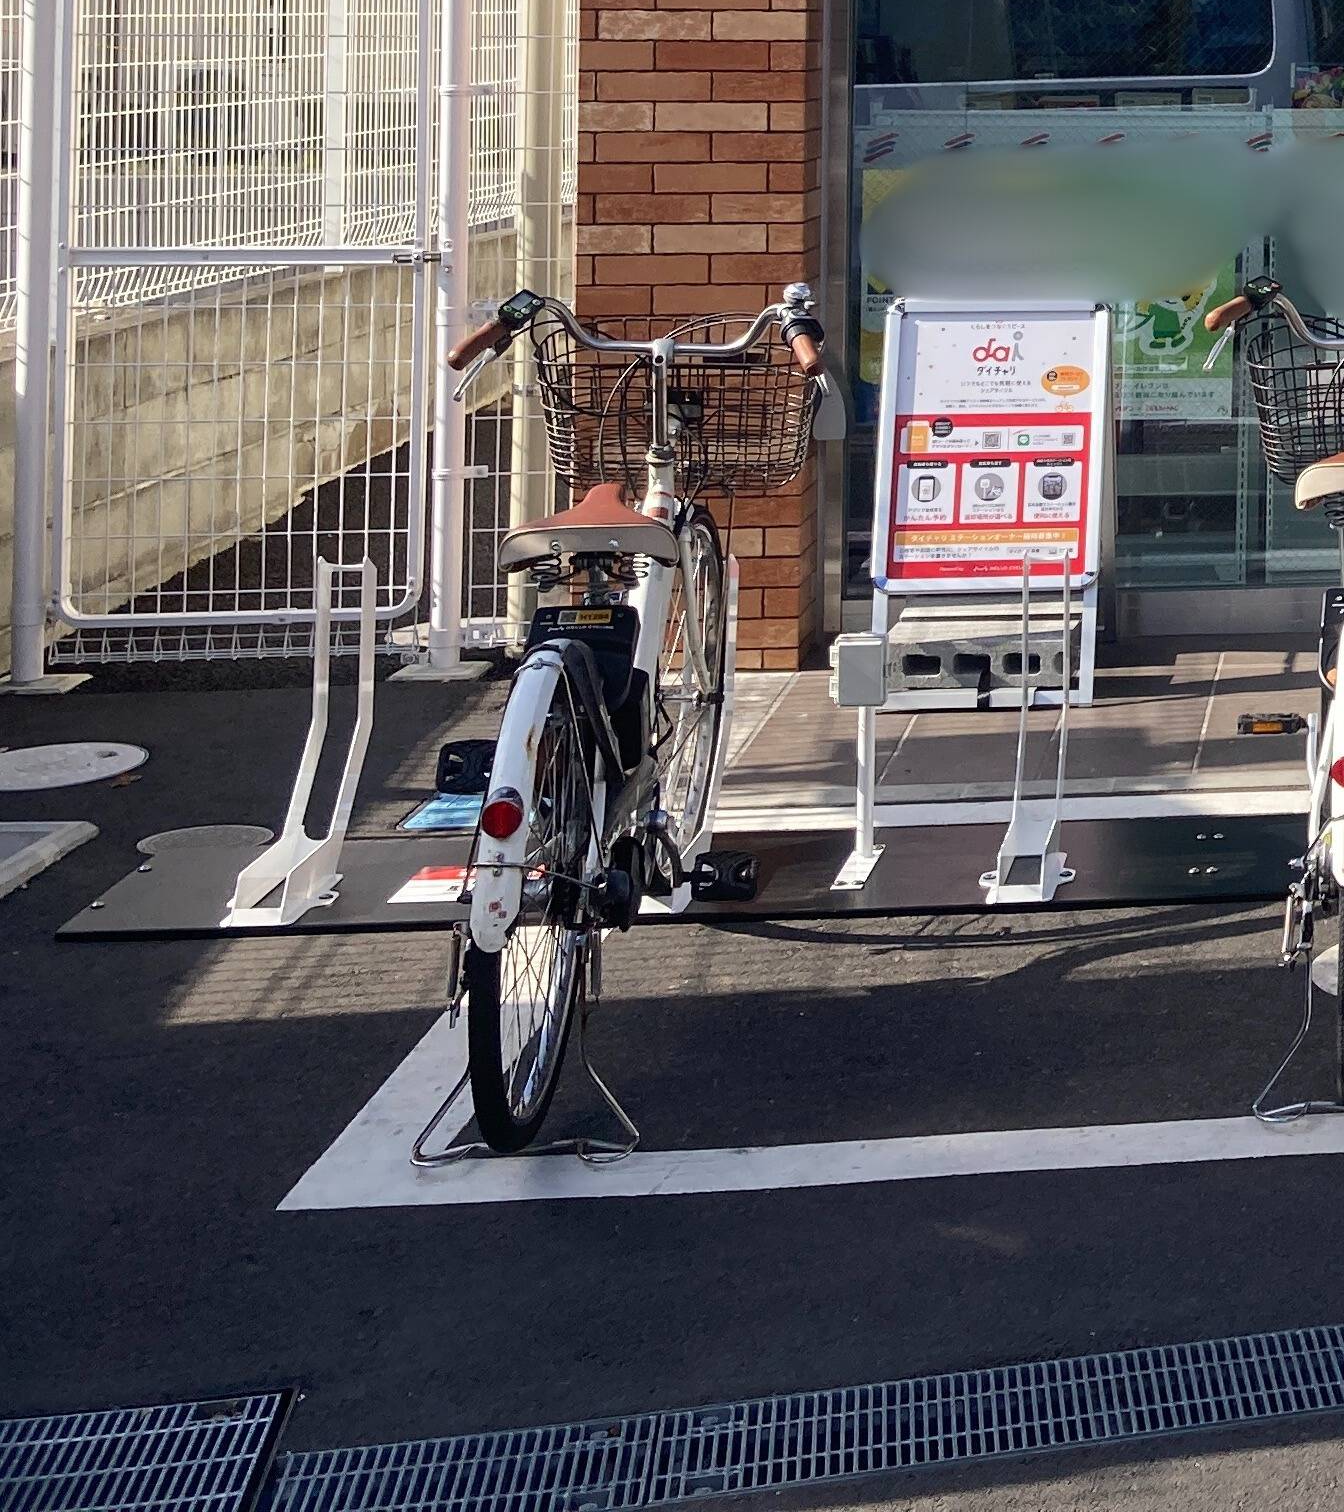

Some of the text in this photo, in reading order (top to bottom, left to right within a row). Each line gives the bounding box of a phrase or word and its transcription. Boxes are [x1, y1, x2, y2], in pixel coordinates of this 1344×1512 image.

[976, 366, 1016, 376] ダイチャリ
